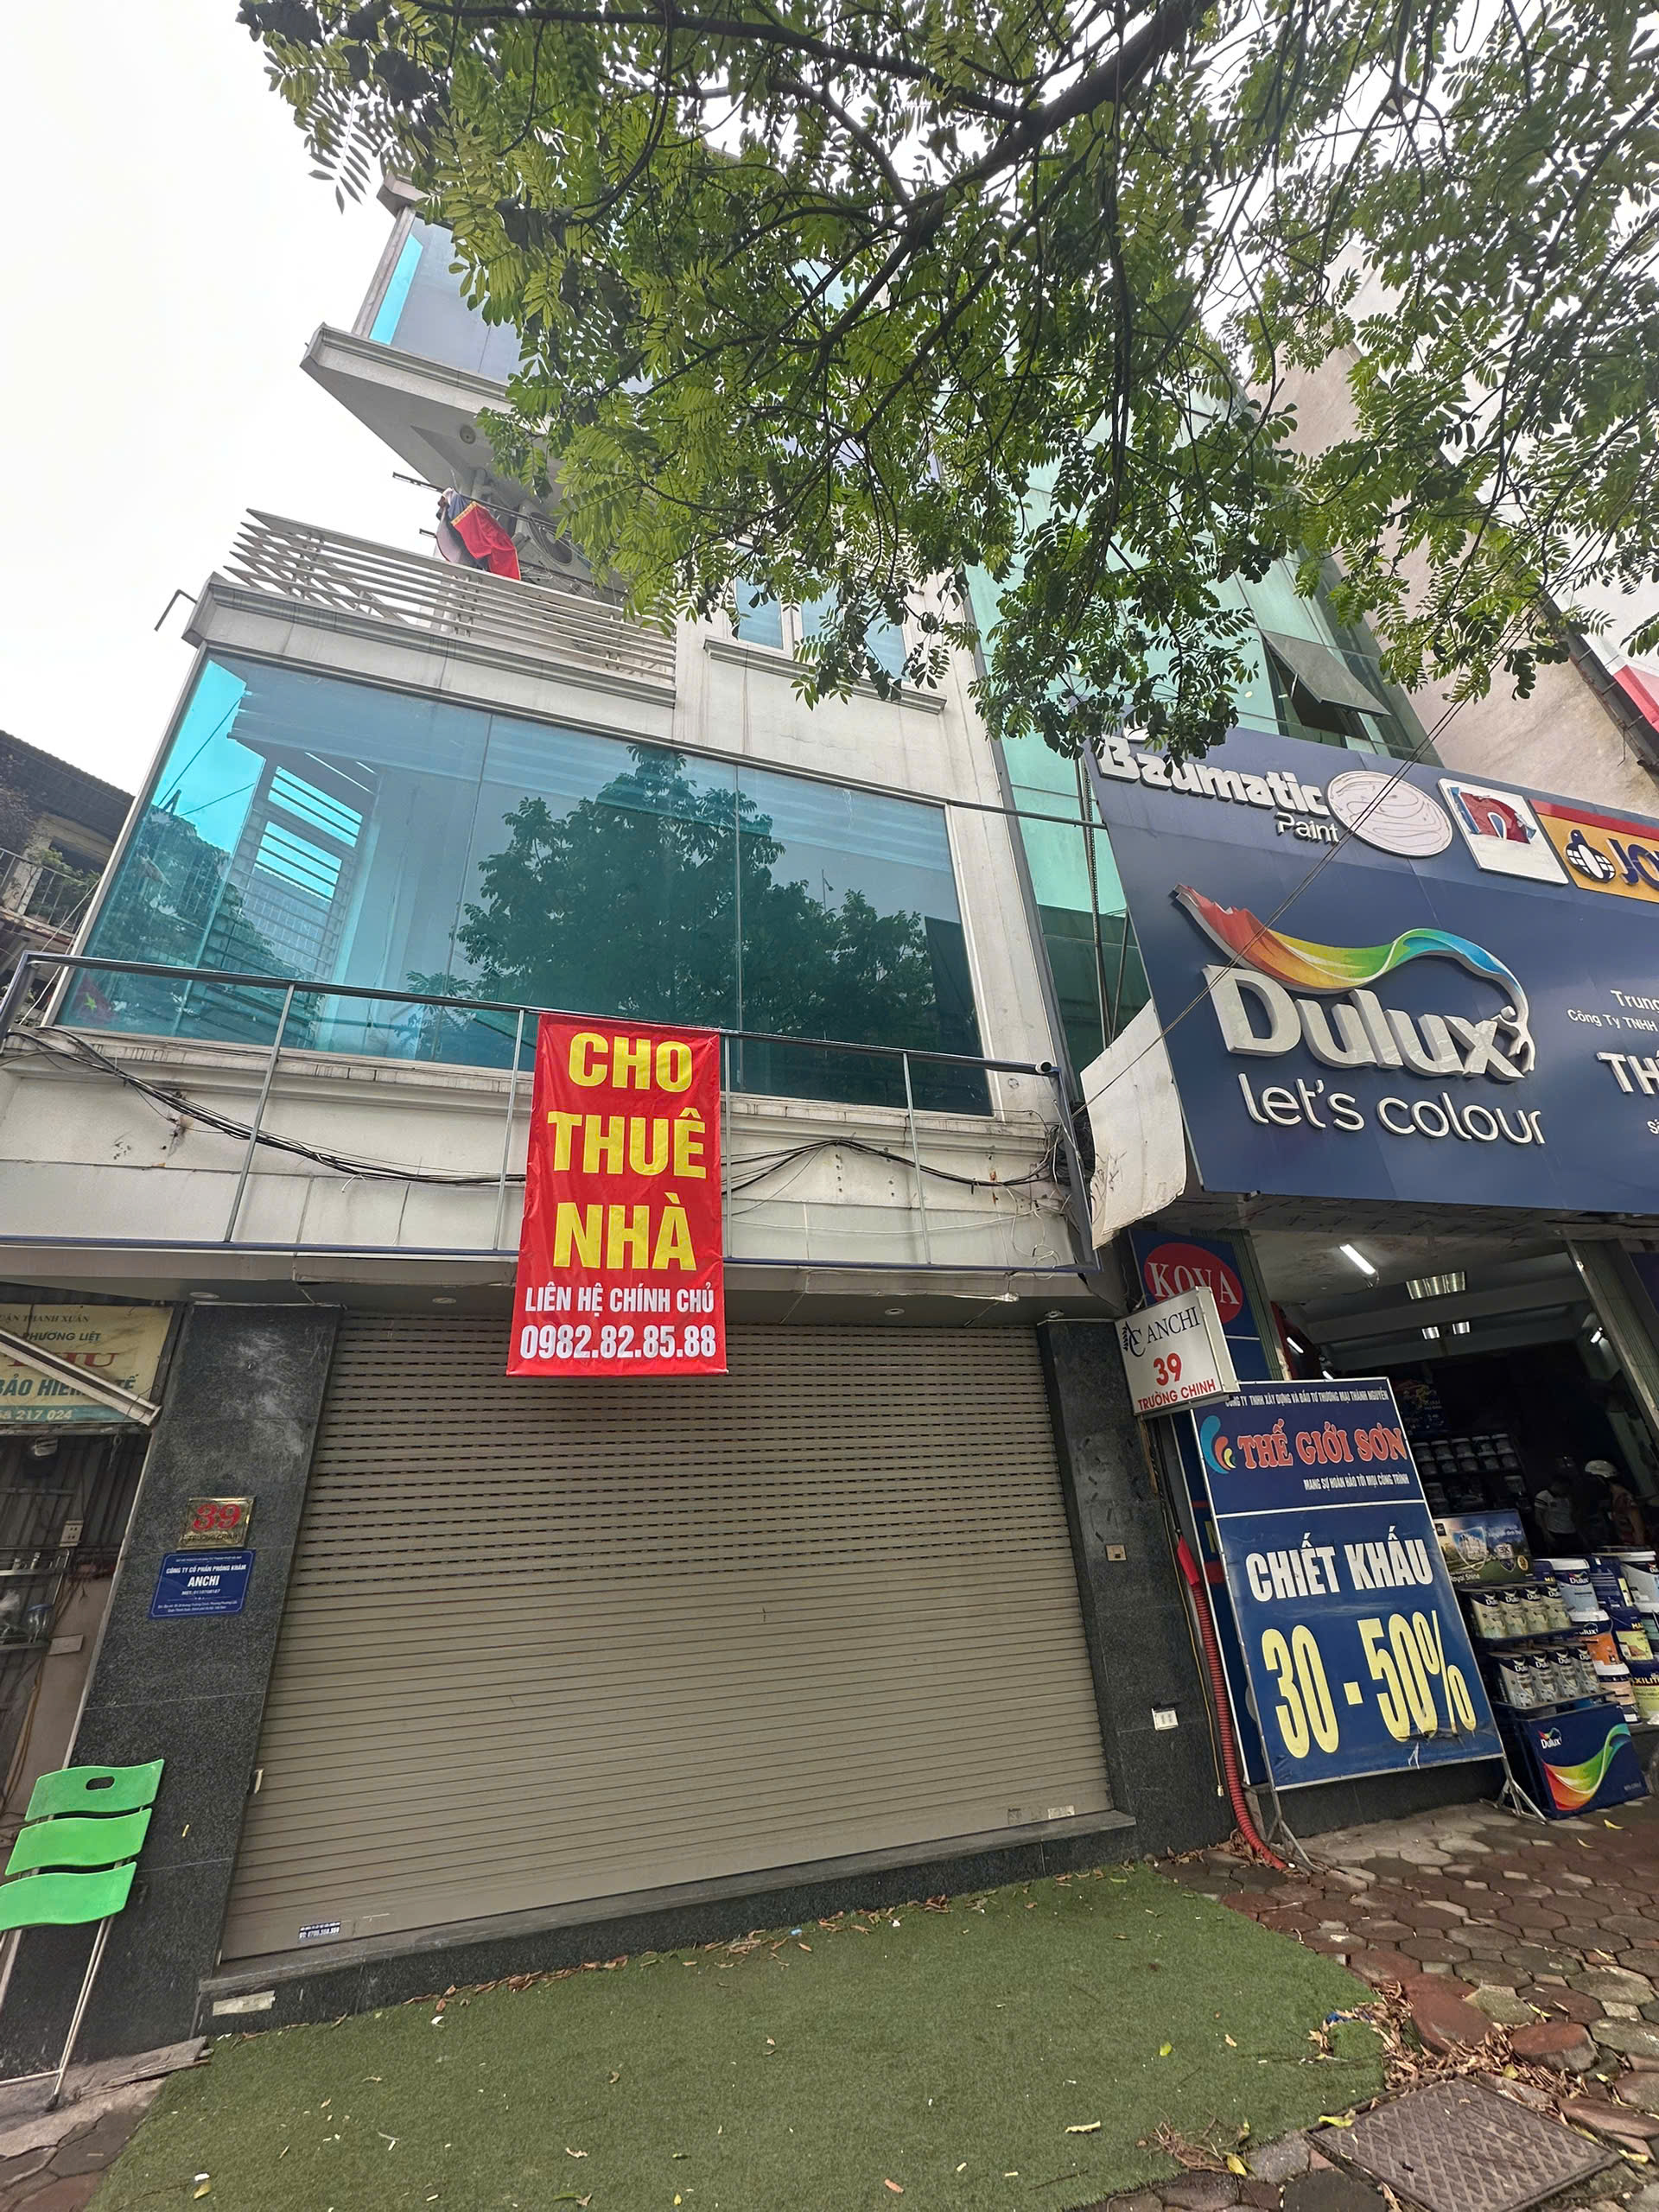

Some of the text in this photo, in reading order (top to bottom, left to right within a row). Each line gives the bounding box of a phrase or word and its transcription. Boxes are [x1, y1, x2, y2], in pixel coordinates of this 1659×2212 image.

[1096, 734, 1331, 817] Baumatic
[1274, 811, 1339, 843] Paint
[1606, 837, 1659, 891] JO
[1202, 964, 1526, 1085] Dulux
[1567, 1009, 1658, 1032] Công Ty TNHH
[568, 1032, 692, 1093] CHO
[1237, 1072, 1546, 1146] let's colour
[547, 1107, 707, 1179] THUÊ
[553, 1192, 697, 1271] NHÀ
[525, 1281, 715, 1317] LIÊN HỆ CHÍNH CHỦ
[1147, 1262, 1240, 1305] KOVA
[519, 1324, 716, 1359] 0982.82.85.88
[1147, 1306, 1201, 1344] ANCHI
[1154, 1352, 1182, 1386] 39
[1180, 1379, 1216, 1399] CHINH
[1237, 1418, 1294, 1469] THẾ
[1354, 1422, 1408, 1462] SƠN
[193, 1503, 242, 1531] 39
[188, 1575, 219, 1587] ANCHI
[1245, 1526, 1433, 1601] CHIẾT KHẤU
[1262, 1625, 1339, 1758] 30
[1357, 1611, 1477, 1742] 50%
[1541, 1736, 1561, 1749] Dulux
